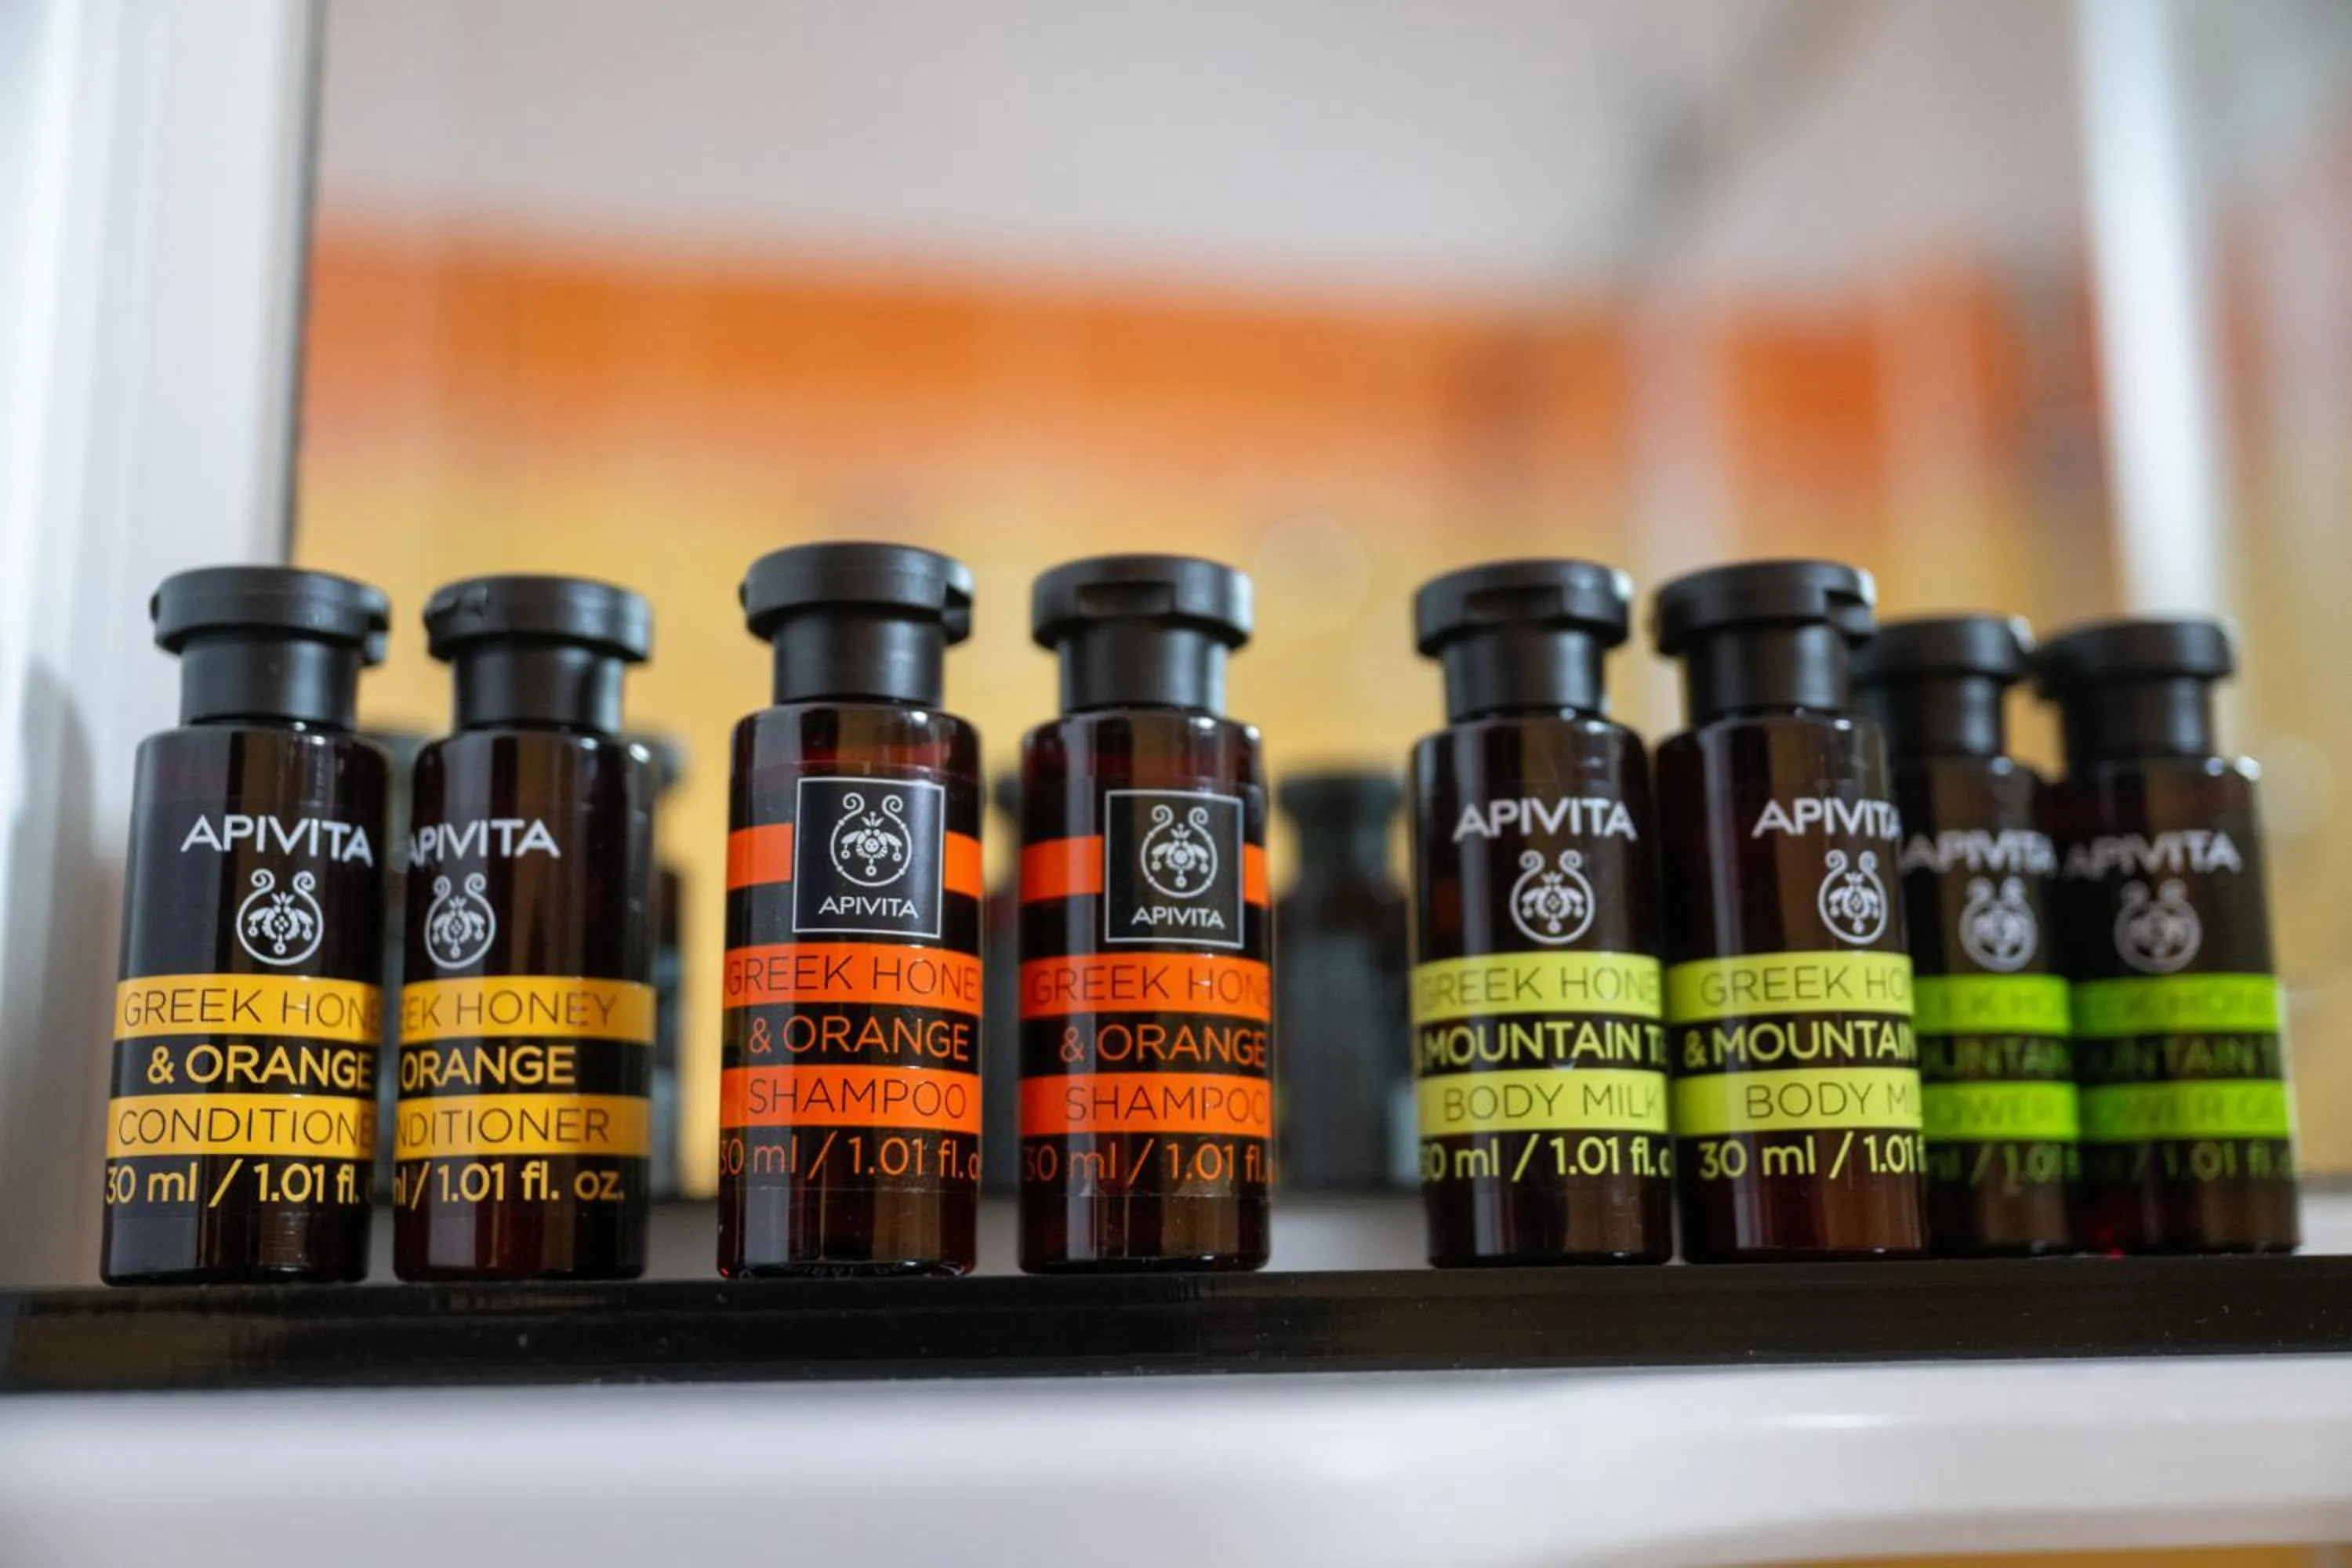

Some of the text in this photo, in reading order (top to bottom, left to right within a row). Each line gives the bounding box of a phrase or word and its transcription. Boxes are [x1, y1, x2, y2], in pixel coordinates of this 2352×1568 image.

[181, 814, 374, 868] APIVITA
[1453, 797, 1639, 842] APIVITA
[818, 896, 919, 918] APIVITA
[1131, 907, 1225, 929] APIVITA
[728, 955, 979, 1003] GREEK HONE
[1033, 965, 1170, 1006] GREEK
[1700, 965, 1851, 1007] GREEK
[124, 989, 263, 1027] GREEK
[456, 989, 617, 1027] HONEY
[750, 1014, 971, 1062] & ORANGE
[1060, 1024, 1267, 1068] & ORANGE
[1424, 1021, 1641, 1067] MOUNTAIN
[1686, 1030, 1707, 1068] &
[147, 1044, 372, 1091] & ORANGE
[401, 1045, 576, 1092] ORANGE
[749, 1077, 967, 1119] SHAMPOO
[1064, 1085, 1267, 1125] SHAMPOO
[1444, 1083, 1563, 1122] BODY
[1746, 1082, 1872, 1119] BODY
[753, 1134, 797, 1174] ml
[808, 1130, 838, 1180] /
[848, 1136, 924, 1176] 1.01
[1069, 1142, 1116, 1180] ml
[1127, 1138, 1155, 1185] /
[1167, 1142, 1234, 1181] 1.01
[1455, 1138, 1500, 1178] ml
[1512, 1134, 1539, 1181] /
[1549, 1137, 1619, 1176] 1.01
[1698, 1140, 1748, 1179] 30
[1762, 1135, 1817, 1175] ml
[1829, 1131, 1853, 1179] /
[106, 1165, 136, 1203] 30
[147, 1162, 197, 1203] ml
[207, 1158, 243, 1207] /
[253, 1163, 325, 1203] 1.01
[411, 1162, 430, 1210] /
[437, 1163, 505, 1203] 1.01
[521, 1160, 560, 1201] fl.
[574, 1171, 625, 1202] oz.
